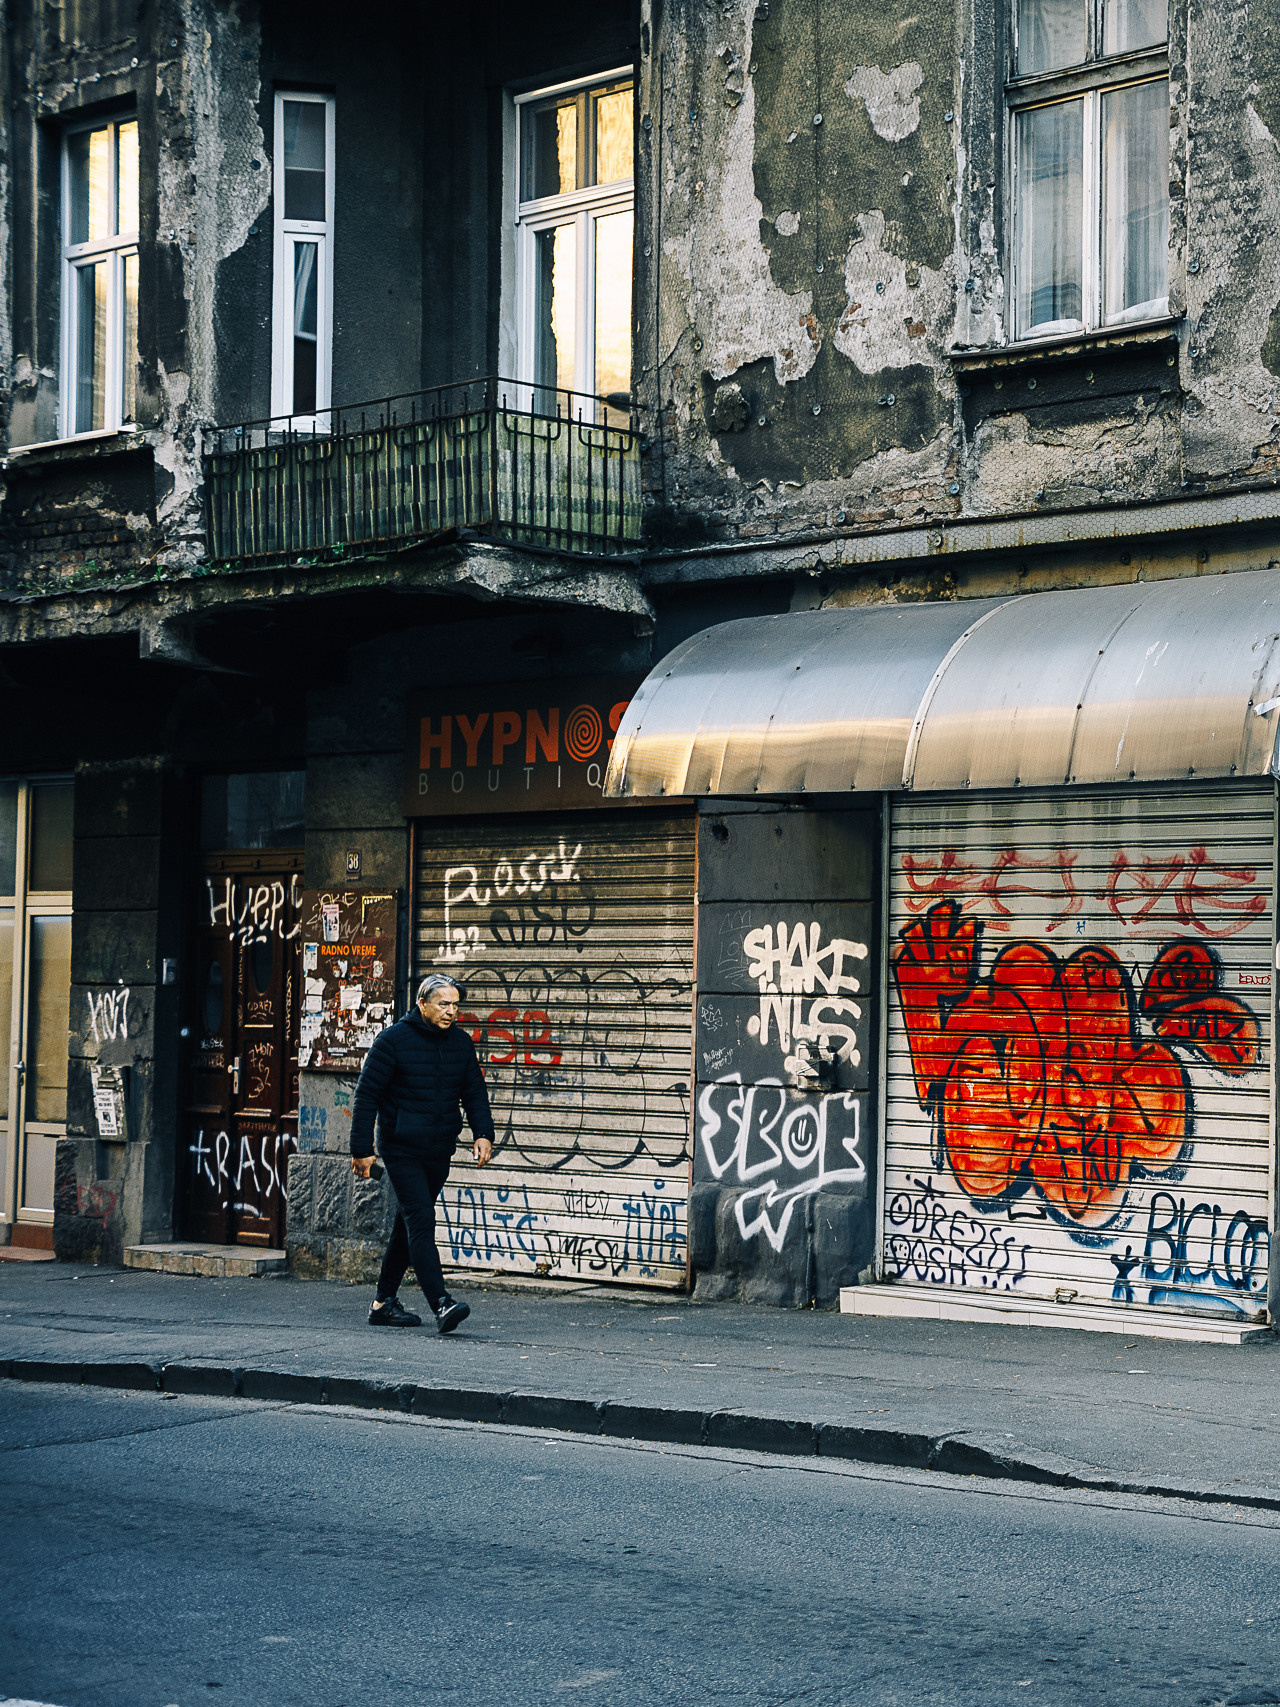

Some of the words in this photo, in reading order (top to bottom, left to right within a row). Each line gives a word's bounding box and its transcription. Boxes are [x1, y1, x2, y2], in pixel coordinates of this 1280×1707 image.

[418, 763, 602, 795] BOUTIQ
[348, 853, 359, 870] 38
[321, 945, 350, 956] RADNO
[351, 945, 377, 956] VREME
